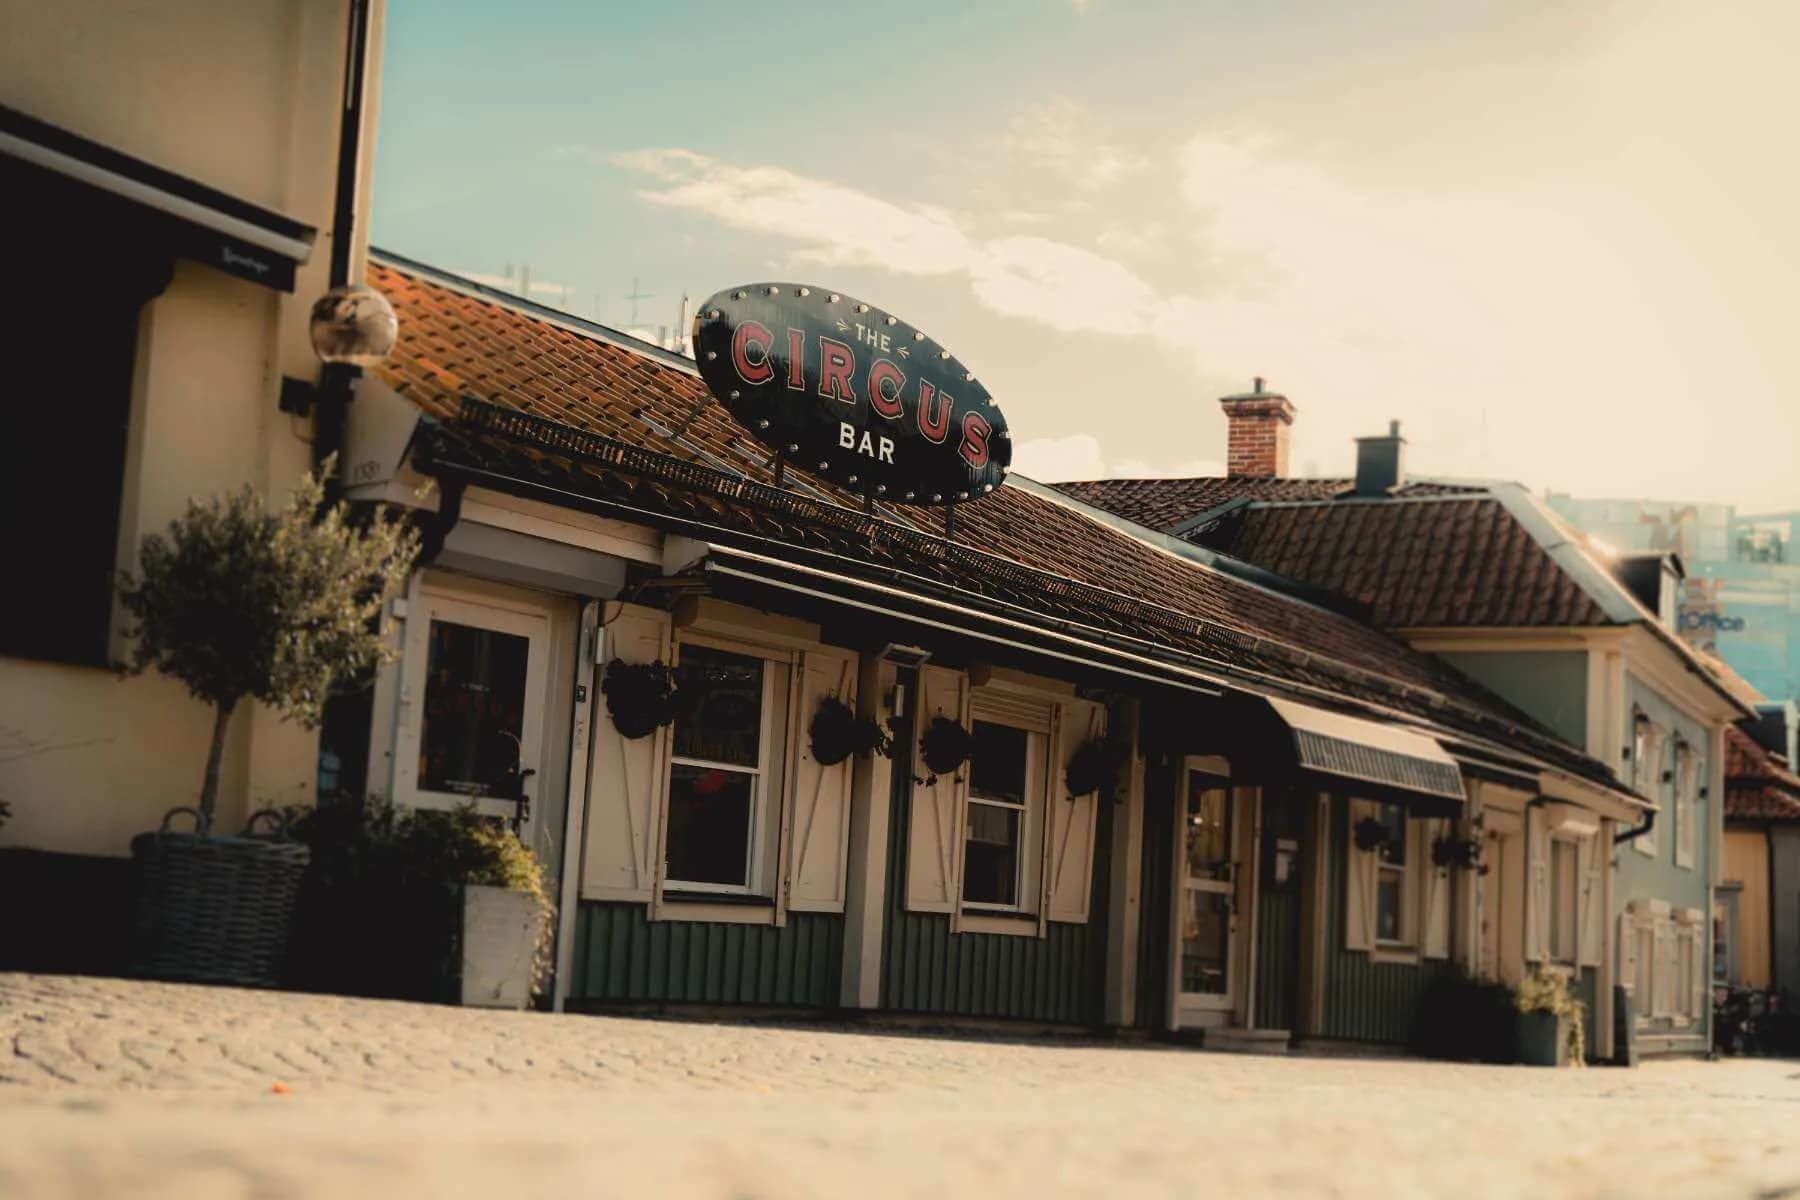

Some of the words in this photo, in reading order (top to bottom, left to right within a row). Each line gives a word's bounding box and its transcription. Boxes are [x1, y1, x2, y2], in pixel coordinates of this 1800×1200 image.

[855, 323, 891, 353] THE
[732, 320, 992, 469] CIRCUS
[838, 422, 895, 464] BAR
